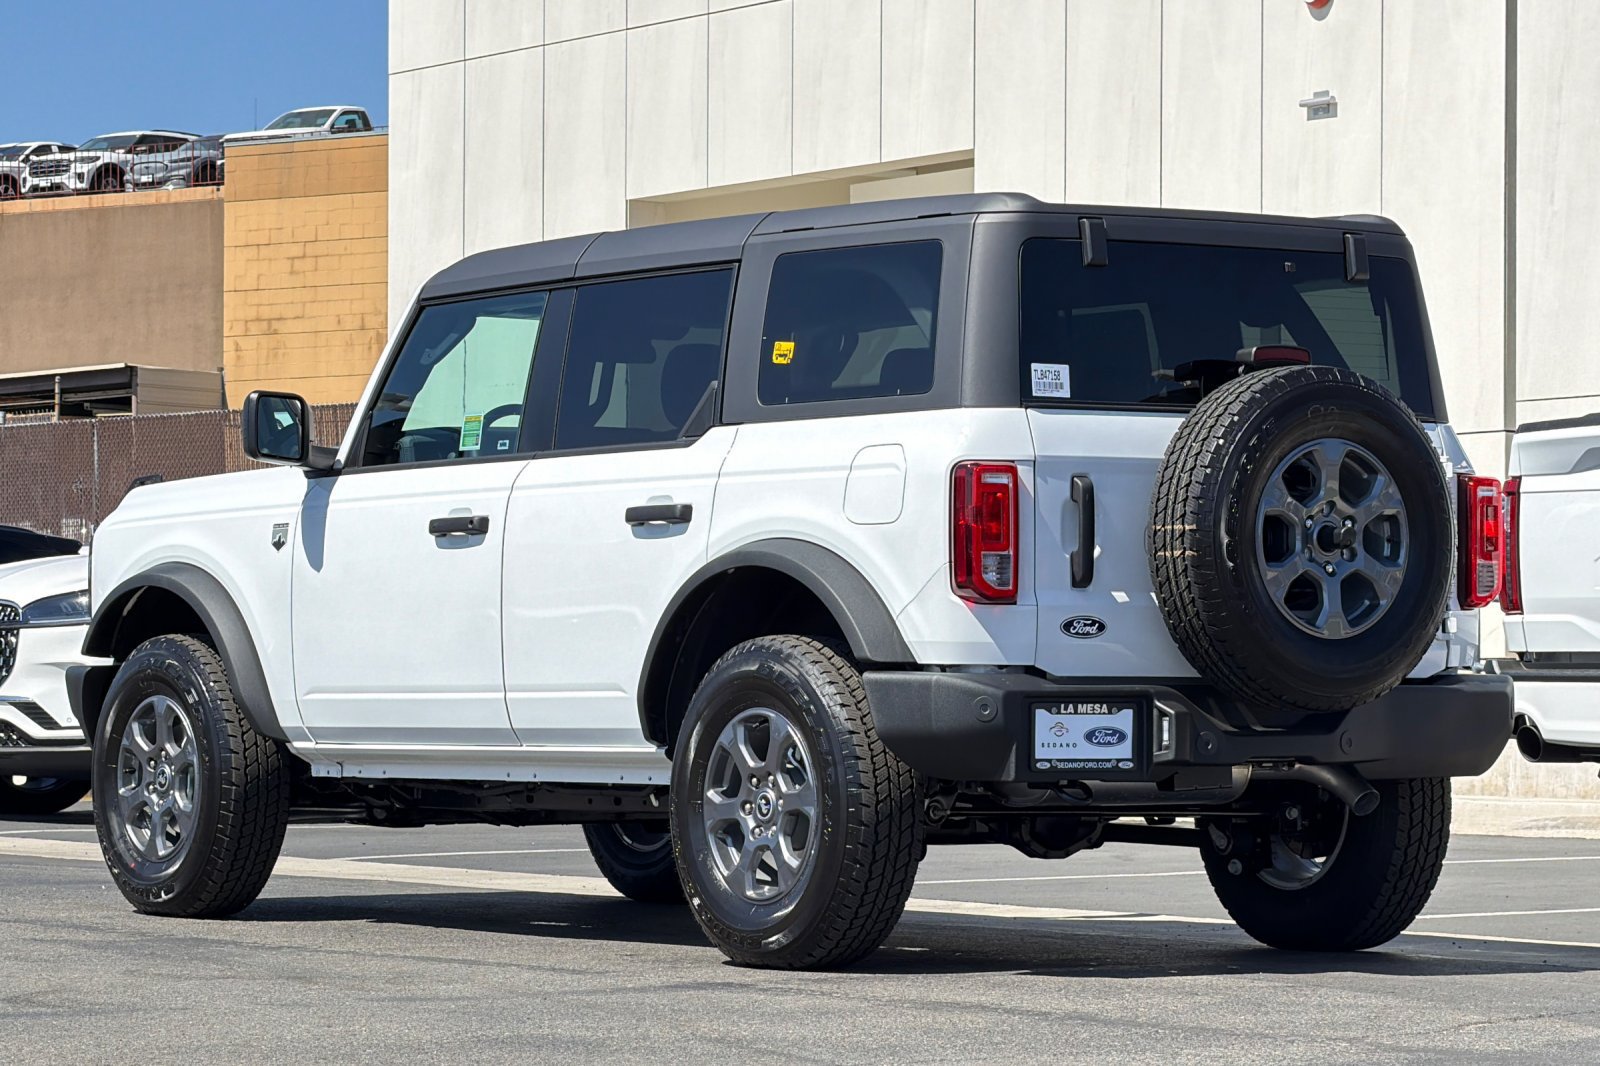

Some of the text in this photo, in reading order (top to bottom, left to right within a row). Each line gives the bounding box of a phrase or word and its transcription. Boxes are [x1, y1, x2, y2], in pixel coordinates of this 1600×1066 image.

[1070, 619, 1099, 634] Ford
[1060, 703, 1109, 714] LA MESA
[1092, 729, 1119, 744] Ford
[1056, 761, 1113, 769] SEDANOFORD.COM
